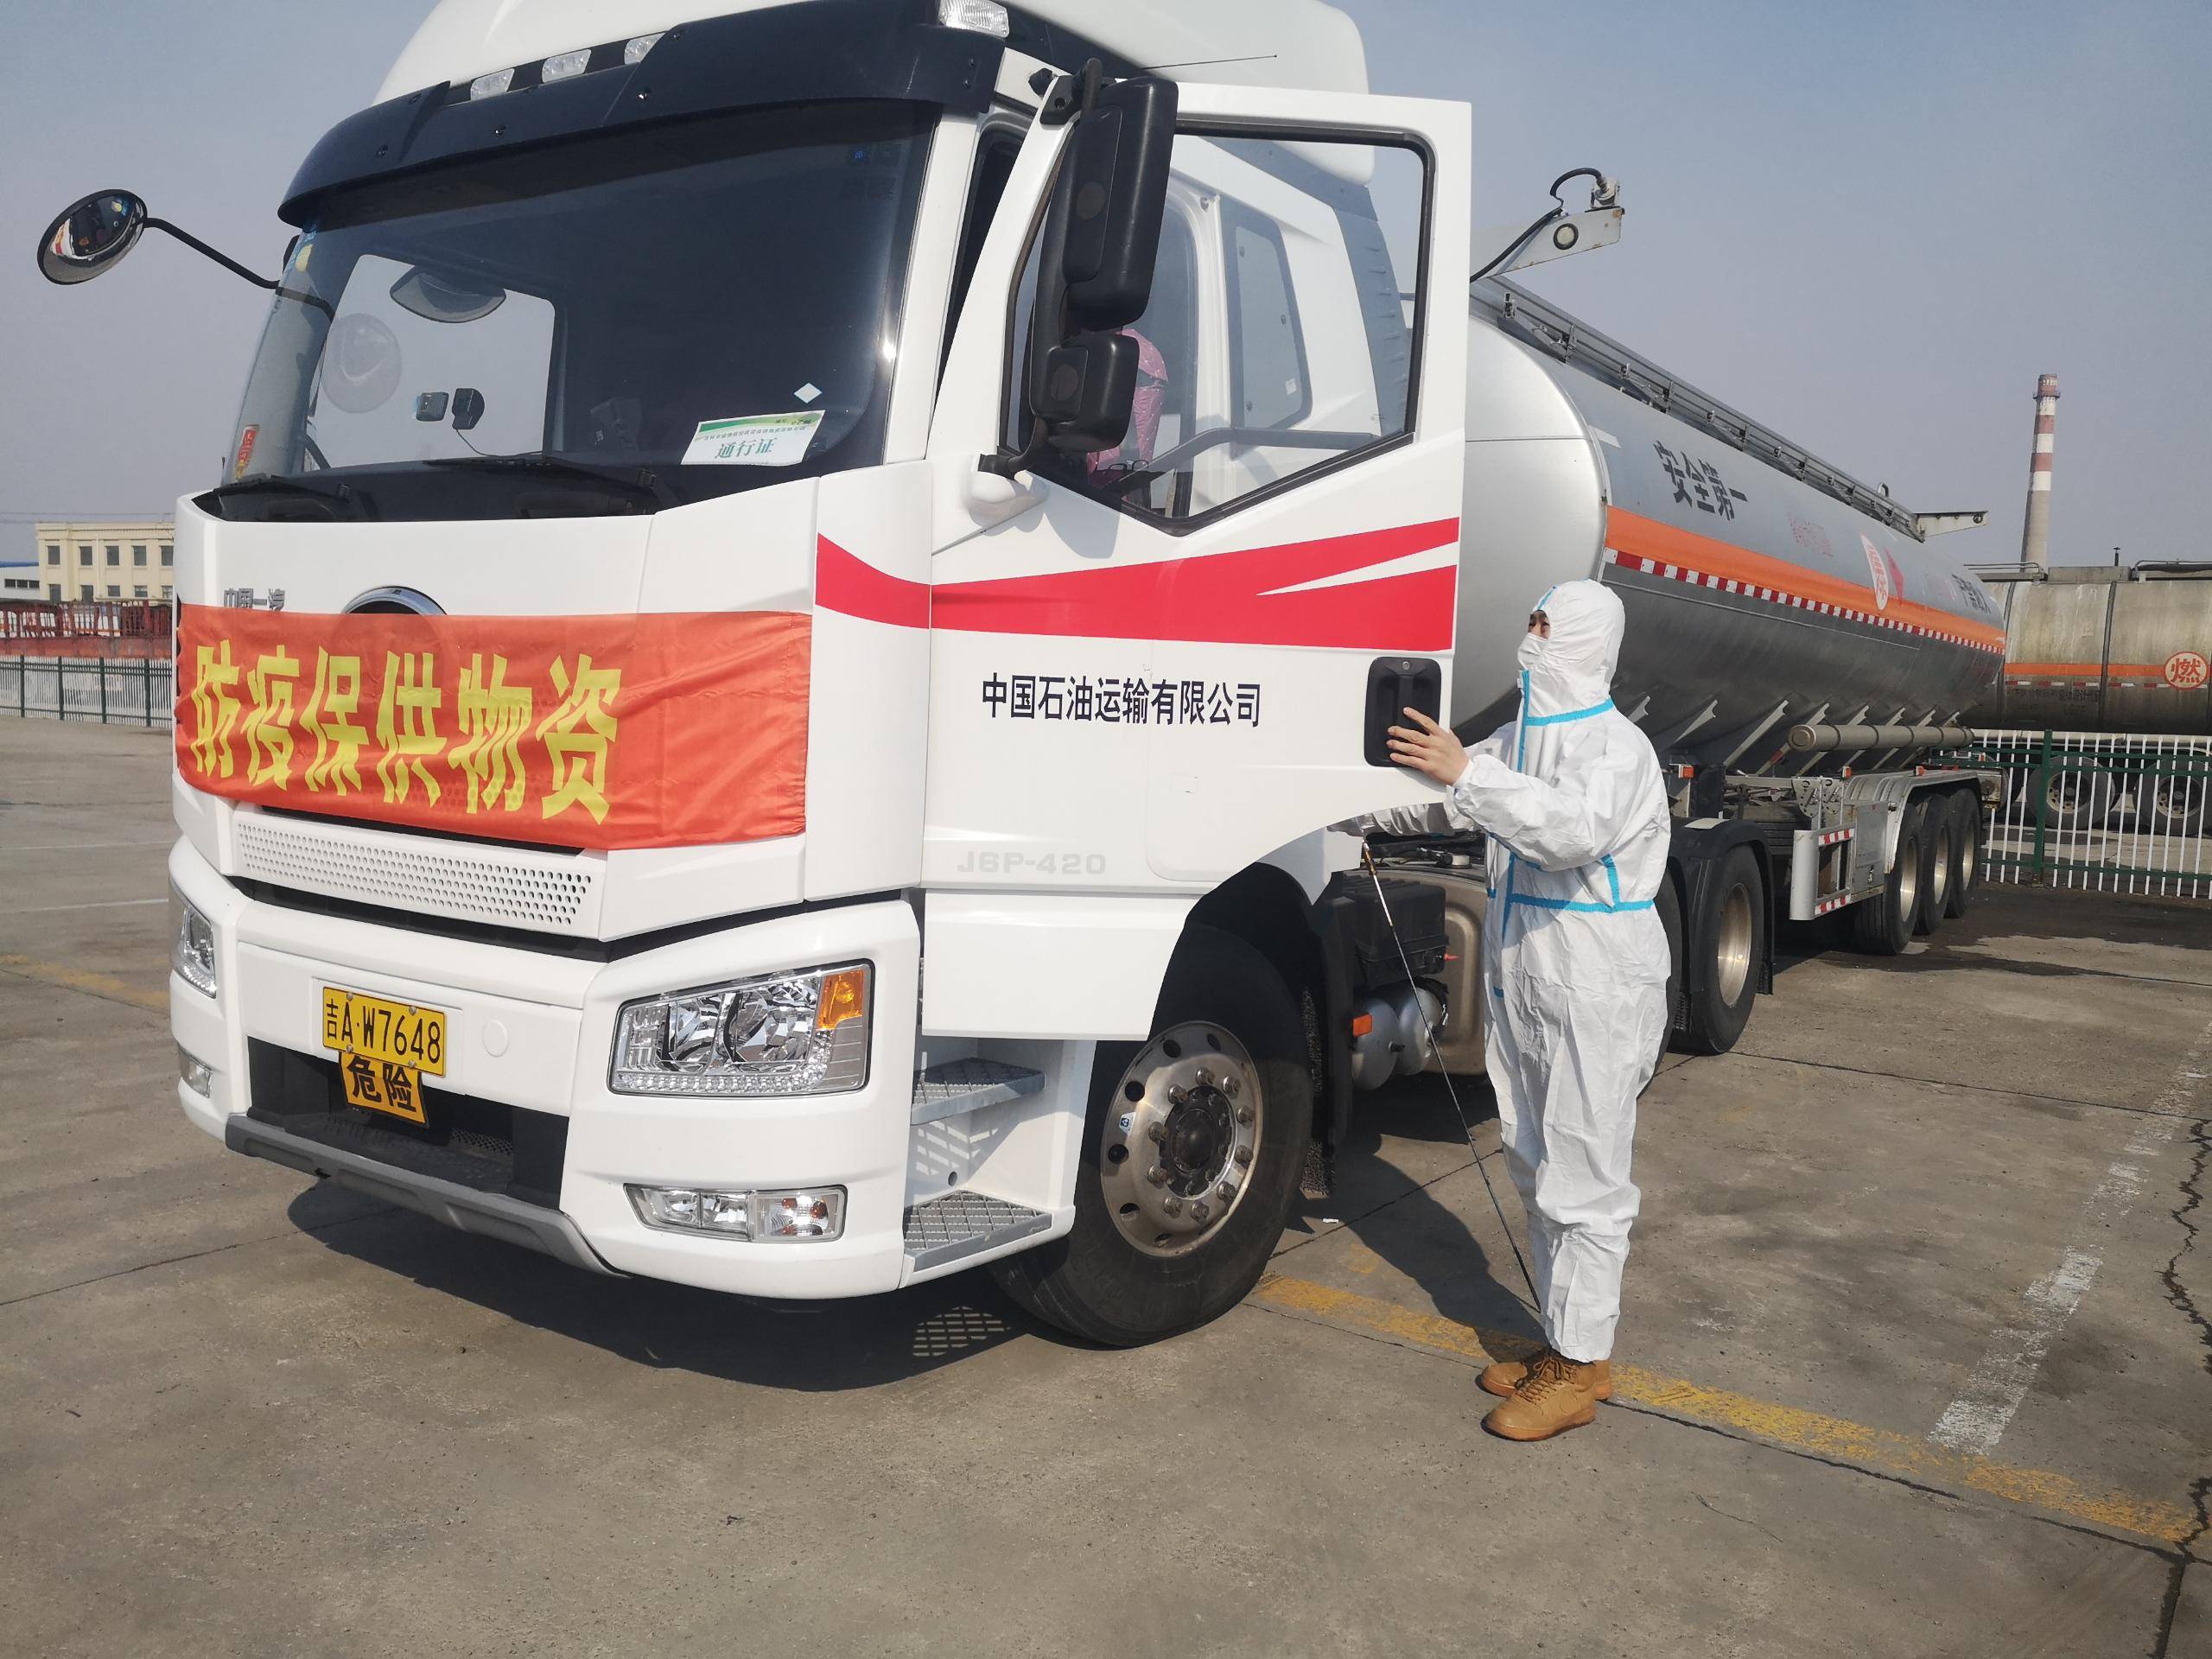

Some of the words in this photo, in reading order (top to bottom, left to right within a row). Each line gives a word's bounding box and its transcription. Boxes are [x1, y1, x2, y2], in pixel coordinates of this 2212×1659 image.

[715, 438, 777, 459] 通行证
[1653, 441, 1748, 521] 安全第一
[2171, 658, 2202, 683] 燃
[982, 672, 1261, 728] 中国石油运输有限公司
[191, 639, 622, 825] 防疫保供物资
[957, 850, 1106, 875] J6P-420
[346, 1054, 416, 1113] 危险
